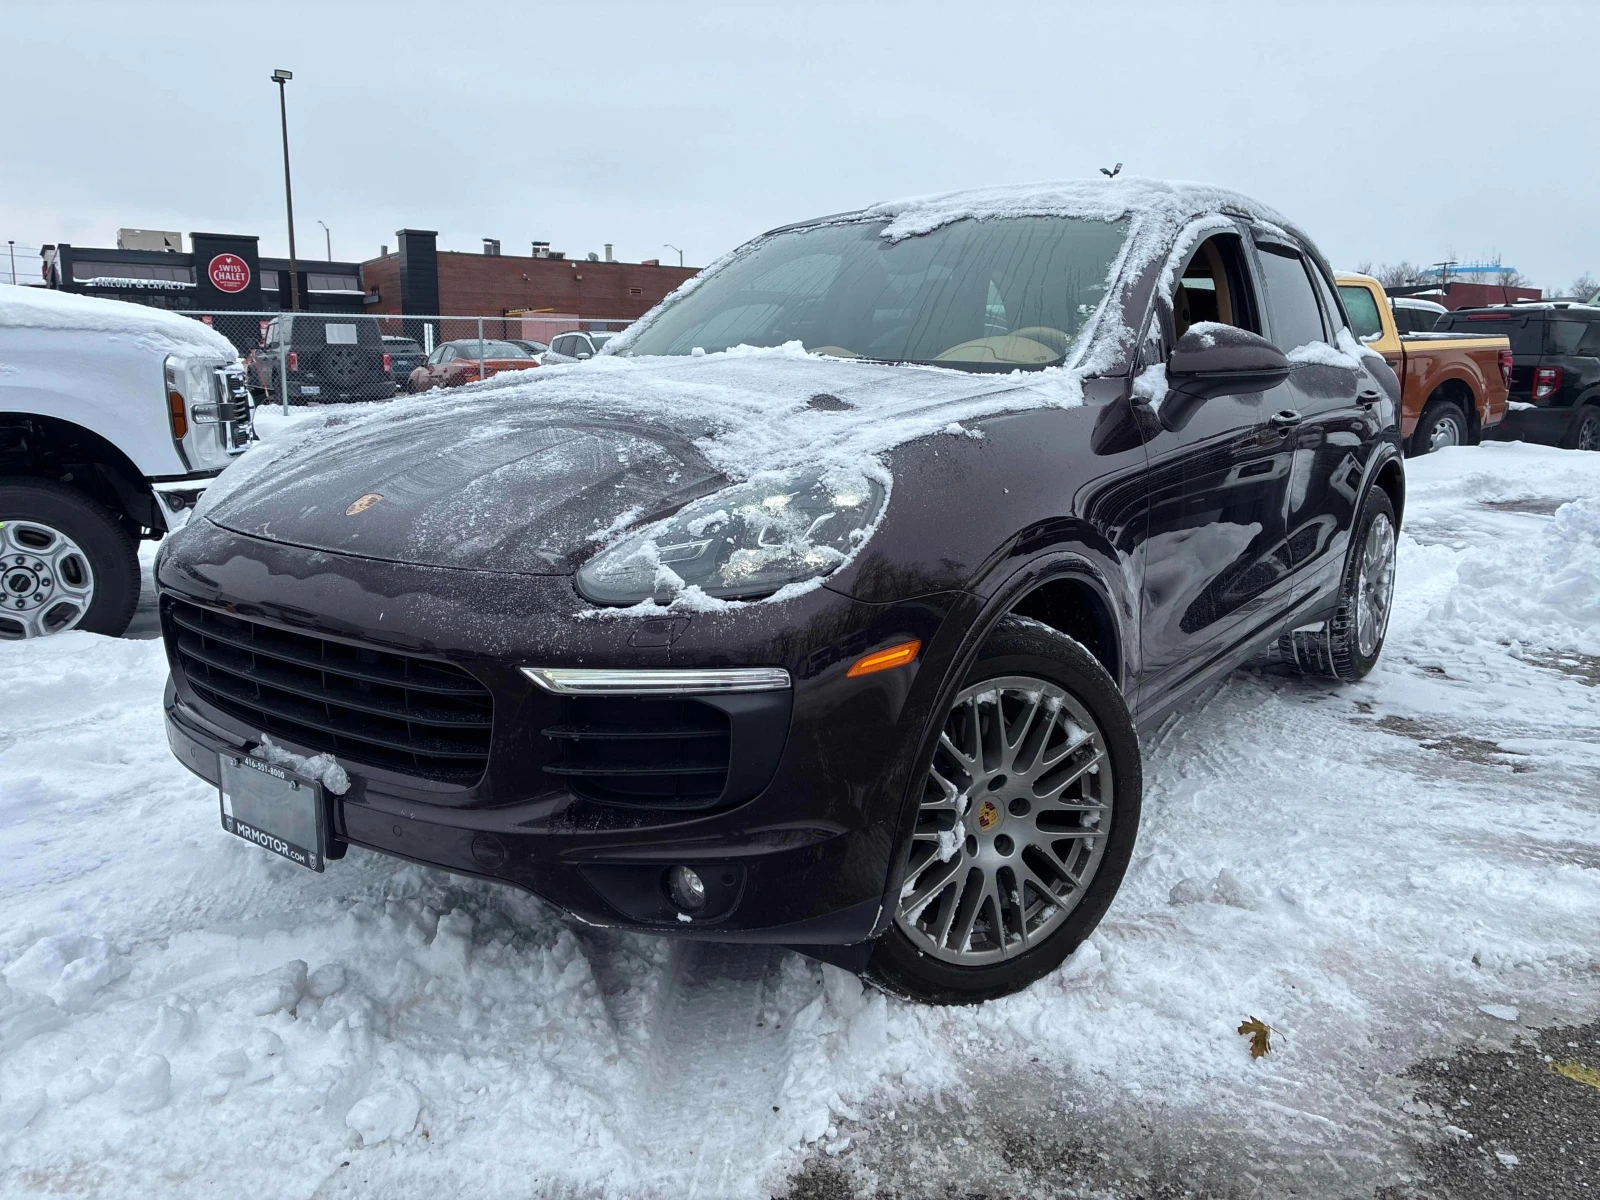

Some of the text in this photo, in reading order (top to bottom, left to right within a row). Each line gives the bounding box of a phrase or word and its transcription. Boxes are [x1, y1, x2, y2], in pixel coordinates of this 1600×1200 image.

[218, 264, 241, 272] SWISS
[213, 269, 245, 281] CHALET
[136, 279, 145, 289] &
[244, 757, 285, 779] 416-551-8000
